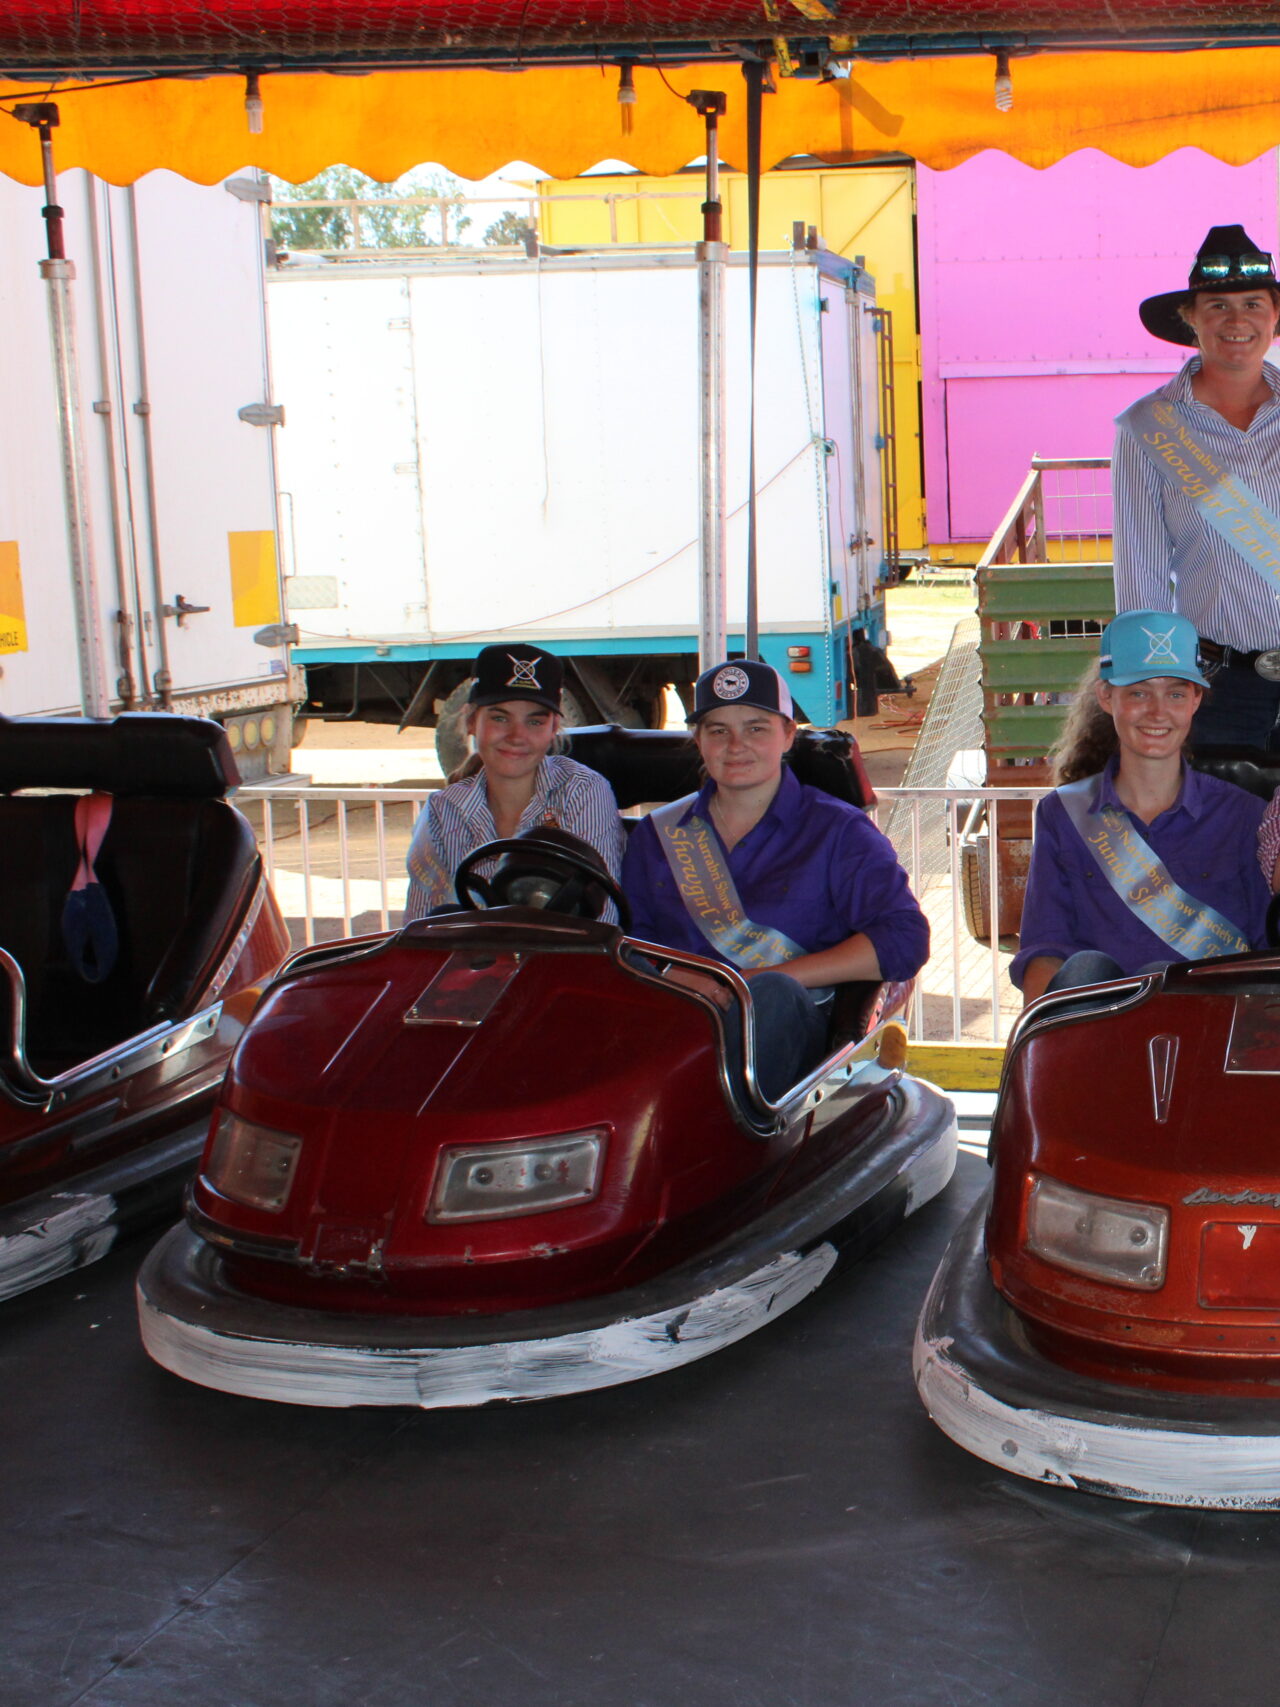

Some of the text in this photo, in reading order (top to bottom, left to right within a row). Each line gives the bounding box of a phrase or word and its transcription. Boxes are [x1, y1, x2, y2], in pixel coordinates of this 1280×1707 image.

[1143, 431, 1239, 519] Showgirl
[1175, 426, 1222, 476] Narrabri
[1217, 472, 1251, 508] Show
[664, 825, 721, 919] Showgirl
[694, 830, 724, 882] Narrabri
[714, 880, 733, 911] Show
[727, 909, 770, 943] Society
[1088, 831, 1209, 950] Junior Showgirl
[1119, 830, 1165, 887] Narrabri
[1158, 883, 1196, 917] Show
[1195, 909, 1233, 945] Society
[1235, 936, 1251, 952] In
